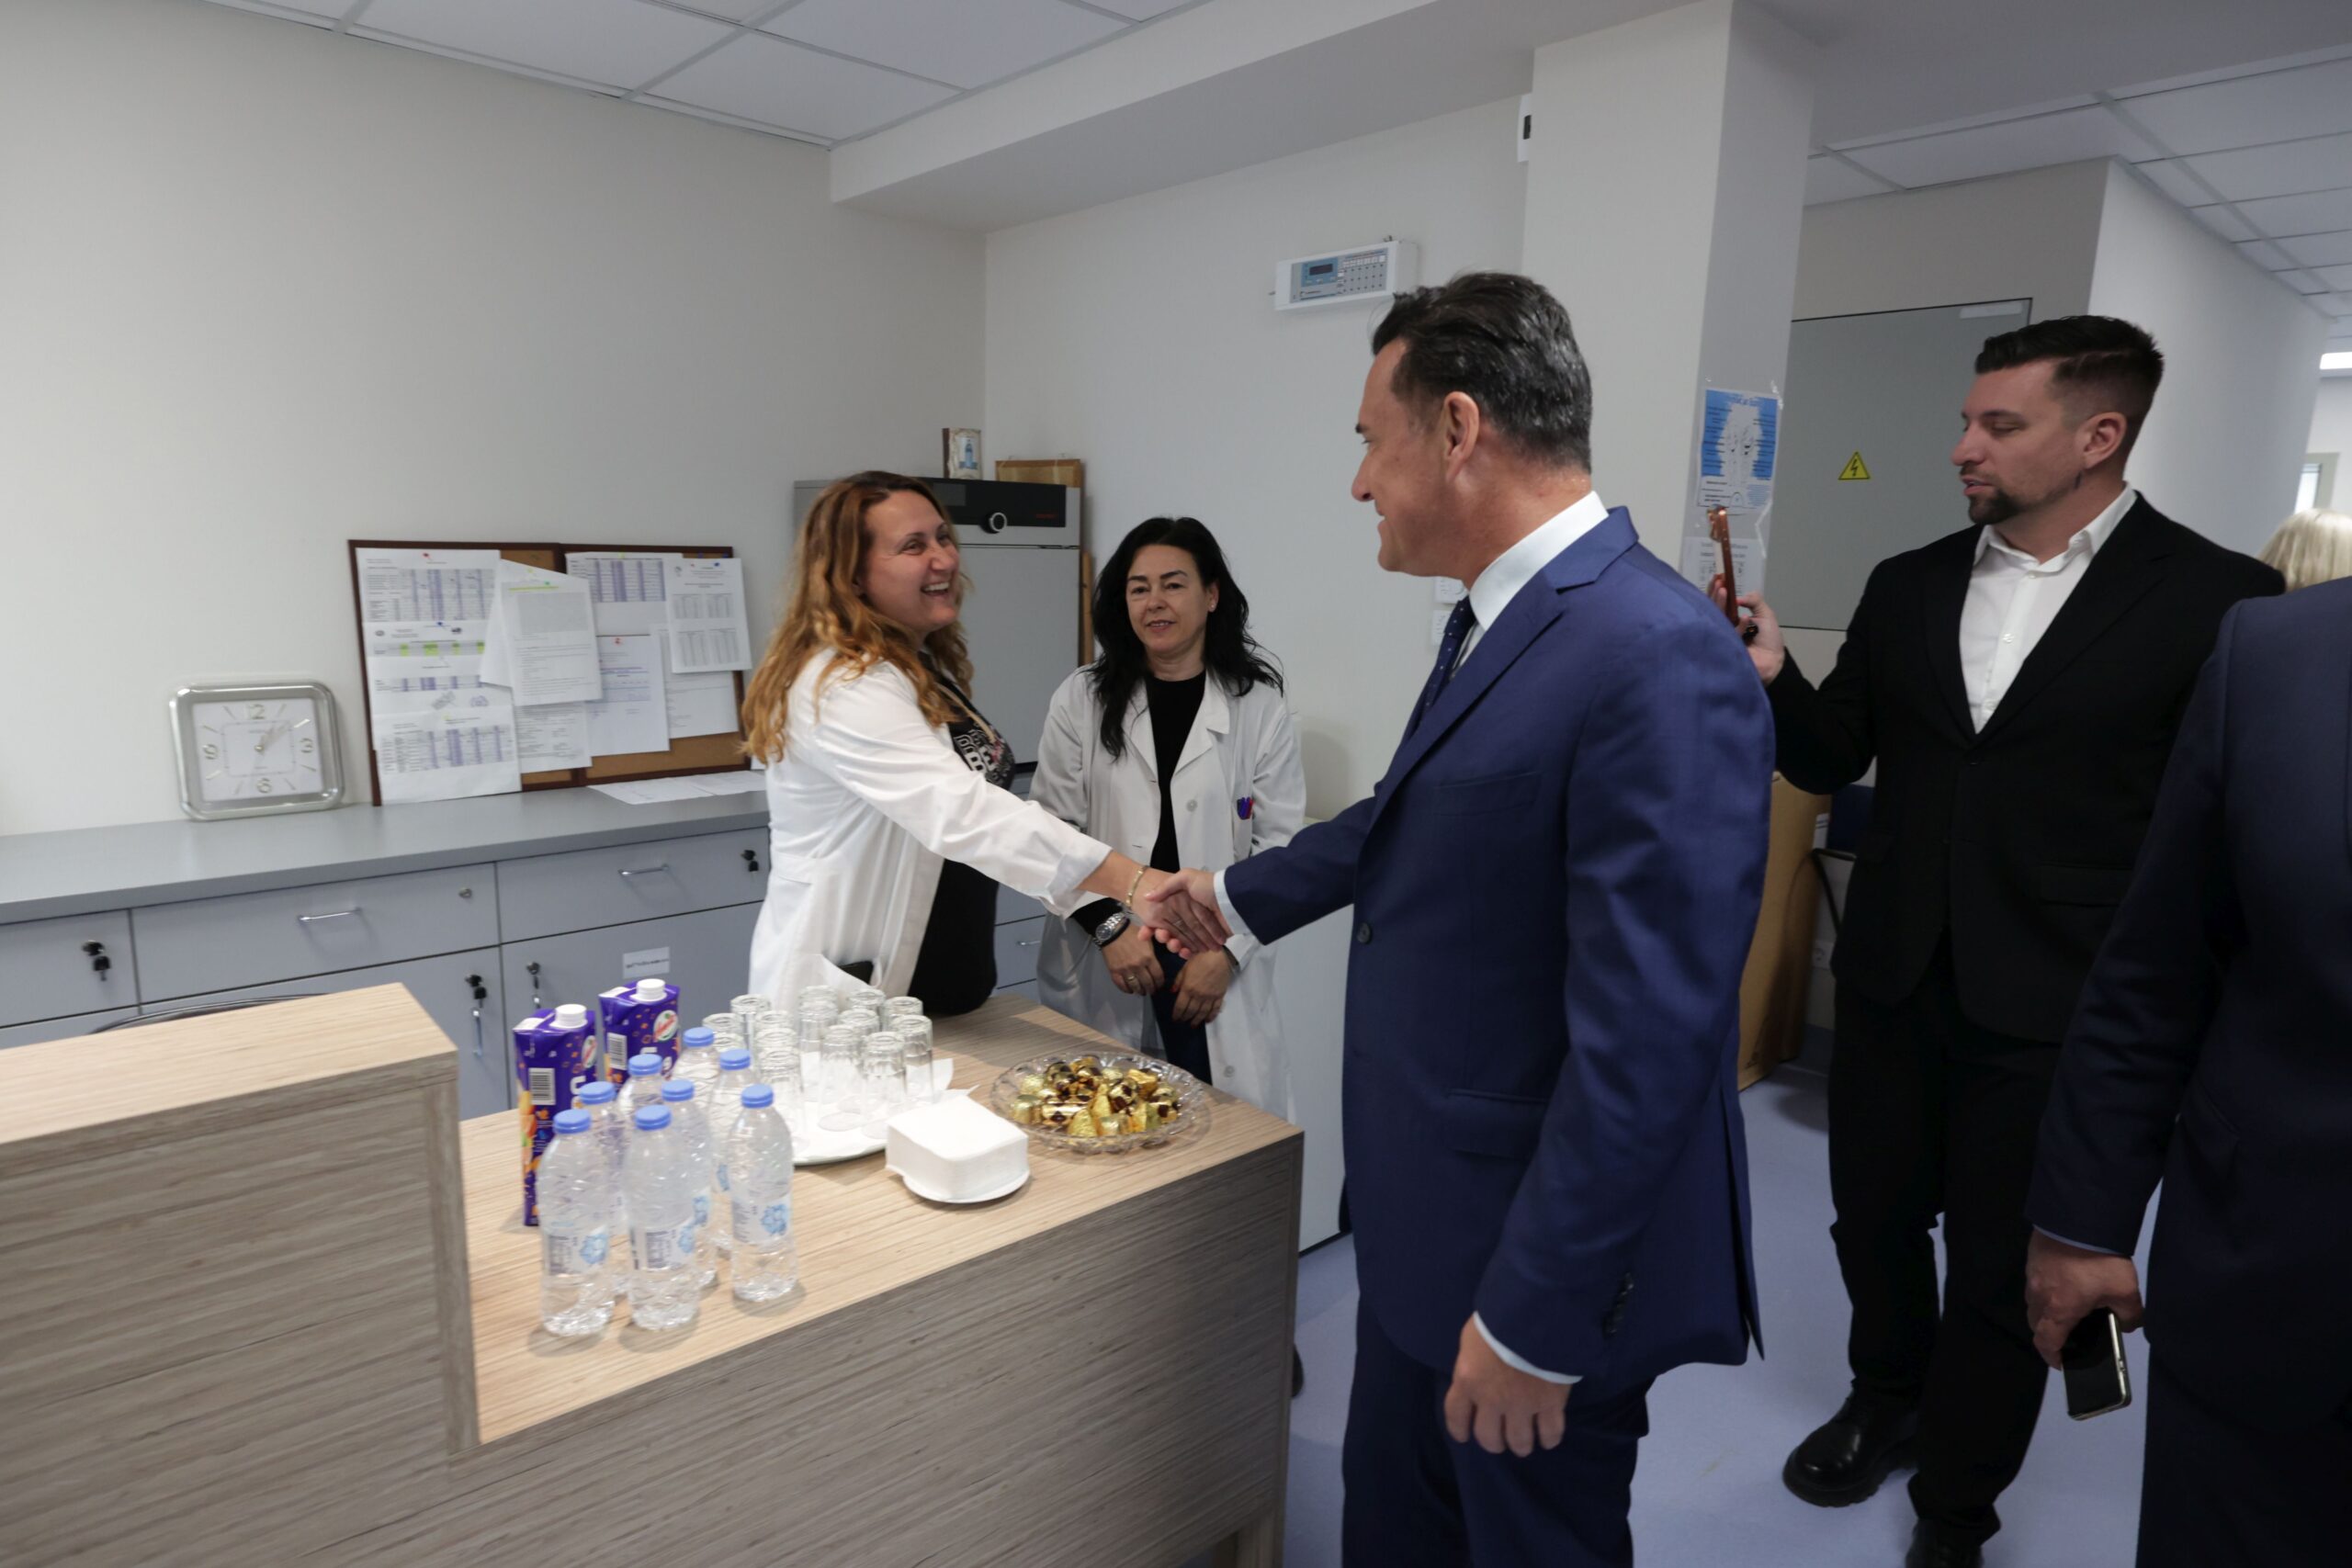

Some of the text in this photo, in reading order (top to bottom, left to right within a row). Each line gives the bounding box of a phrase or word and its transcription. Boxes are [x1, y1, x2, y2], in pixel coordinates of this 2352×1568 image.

[248, 704, 266, 720] 12
[203, 743, 219, 761] 9
[300, 738, 314, 754] 3
[257, 777, 273, 794] 6
